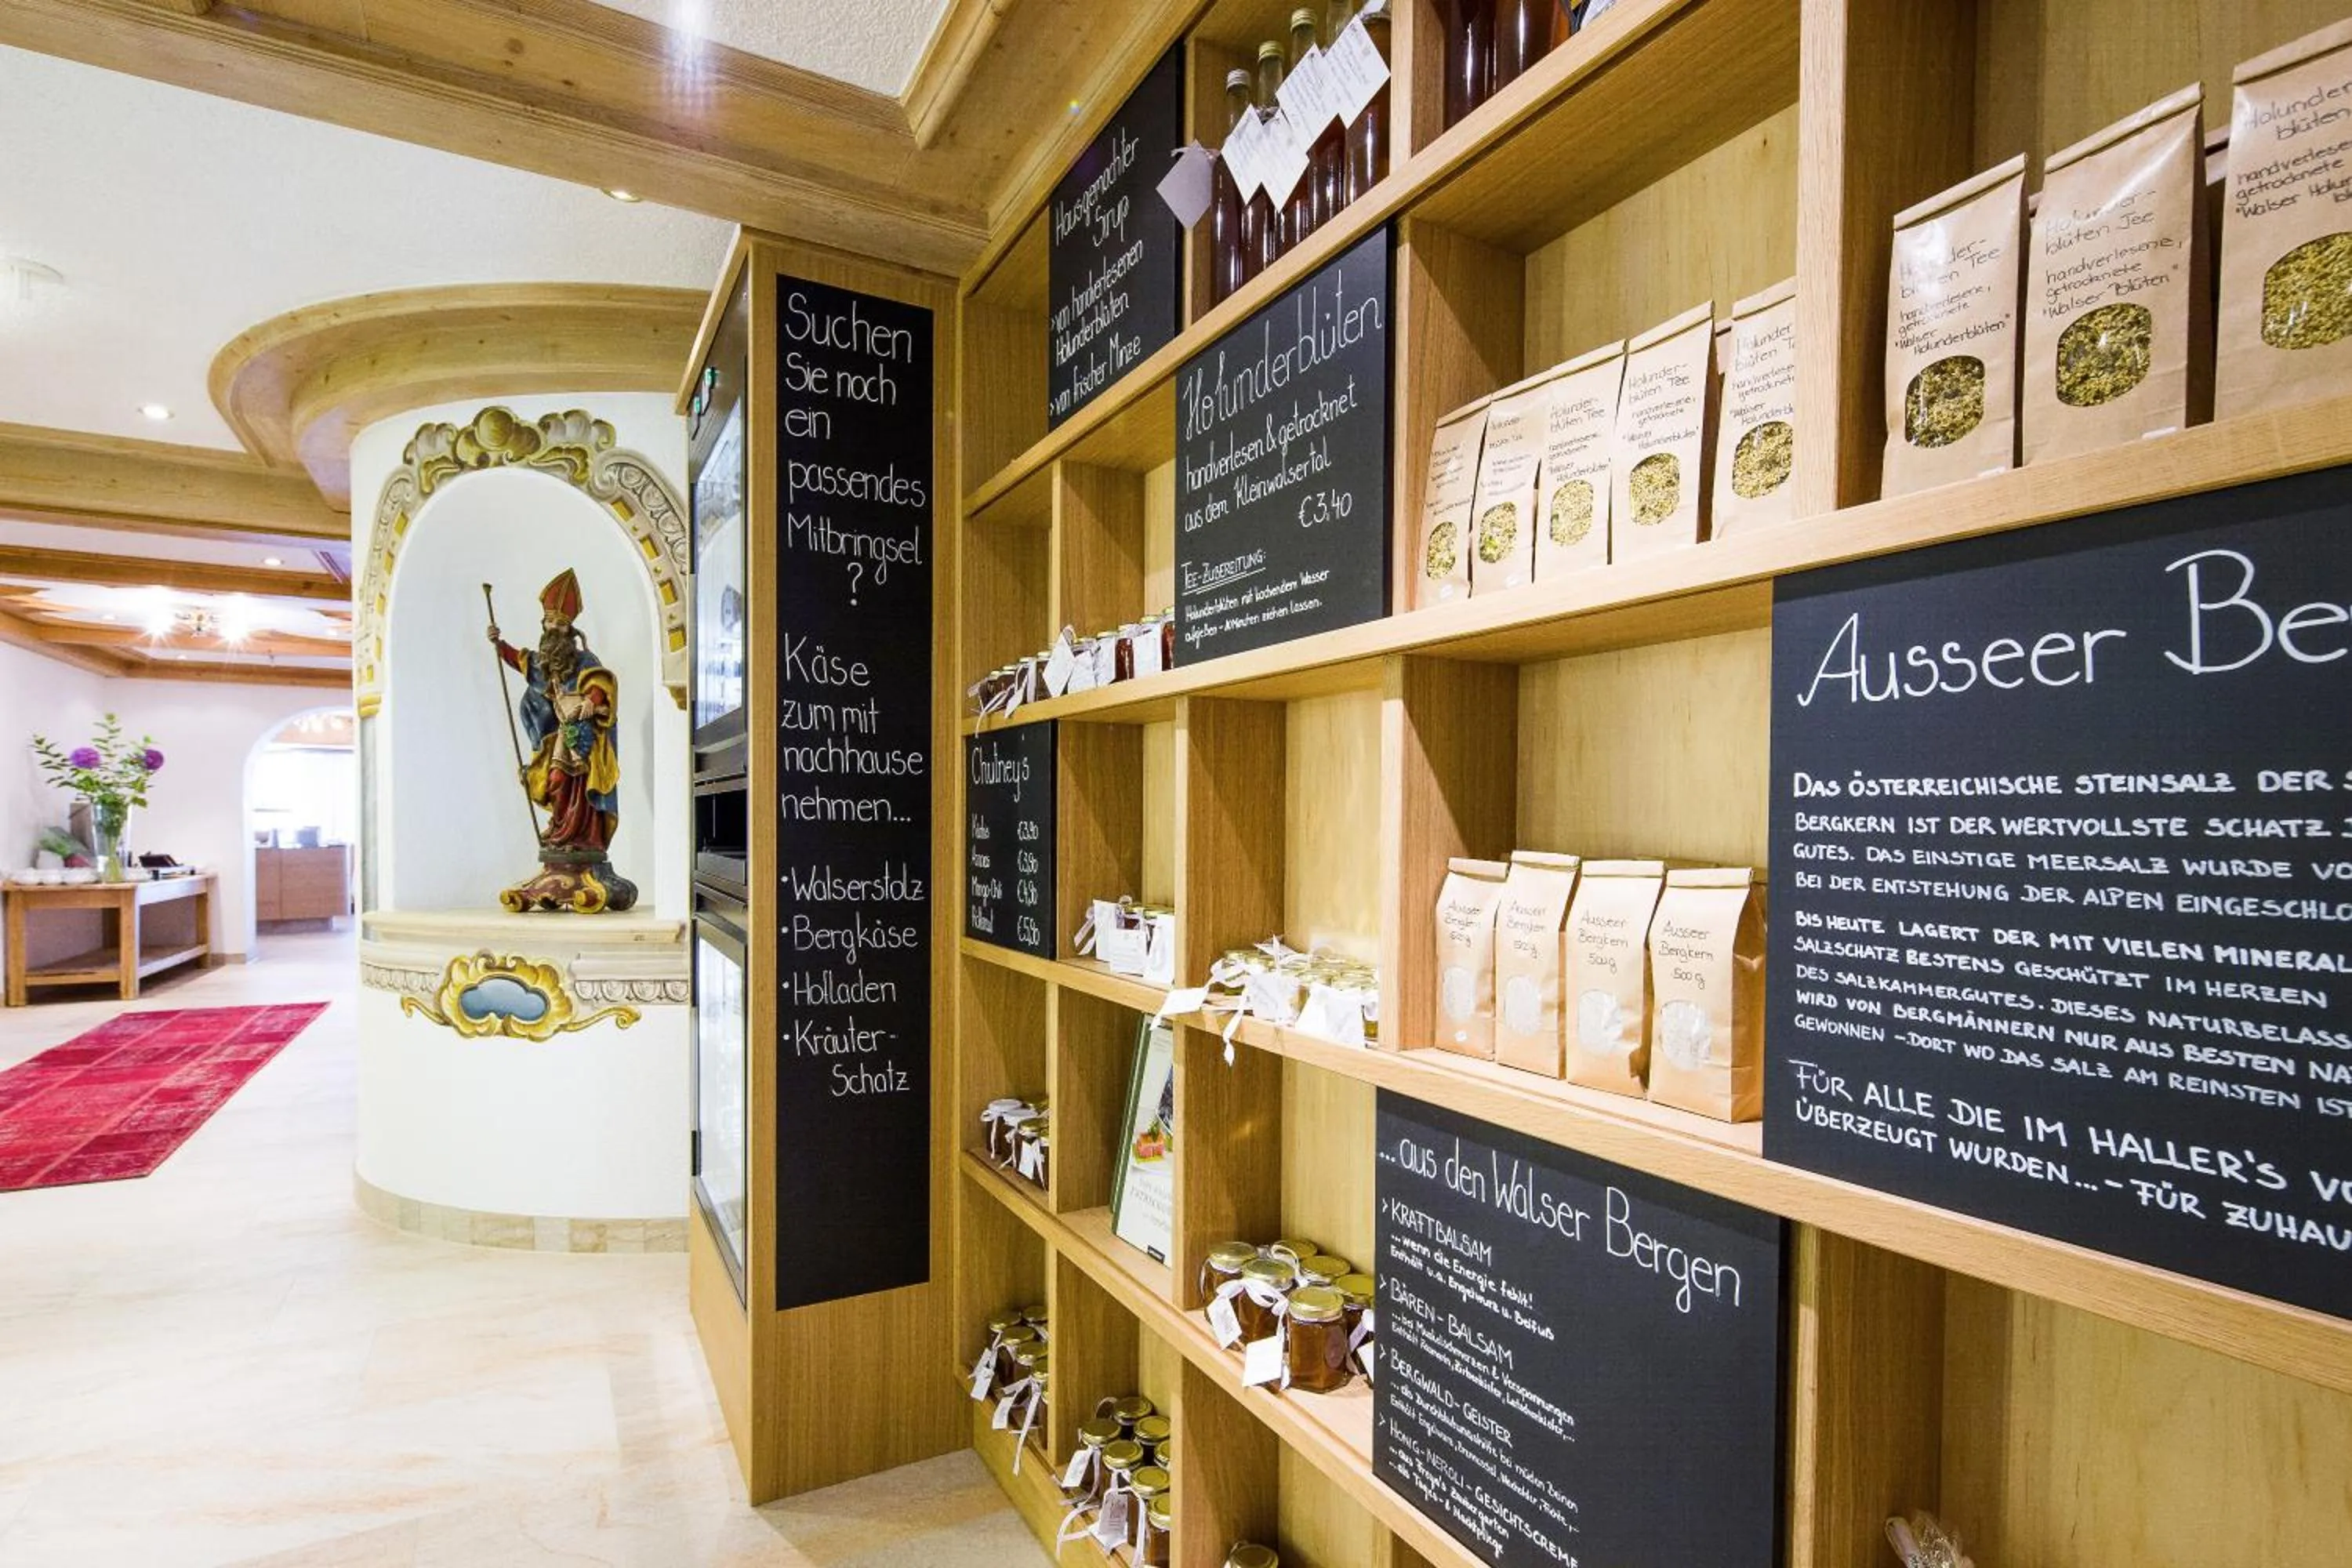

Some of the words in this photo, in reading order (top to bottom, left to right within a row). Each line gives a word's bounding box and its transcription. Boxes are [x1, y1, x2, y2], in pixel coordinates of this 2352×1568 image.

[785, 292, 912, 363] Suchen
[785, 352, 828, 393] Sie
[837, 363, 896, 405] noch
[1183, 269, 1382, 441] Holunderblüten
[785, 408, 830, 440] ein
[788, 459, 926, 507] passendes
[1186, 431, 1265, 495] handverlesen
[1185, 505, 1203, 532] aus
[1205, 492, 1230, 523] dem
[1298, 488, 1352, 528] €3,40
[788, 512, 923, 585] Mitbringsel
[847, 561, 863, 606] ?
[1798, 613, 2126, 706] Ausseer
[2165, 549, 2352, 674] Be
[785, 632, 871, 686] Käse
[782, 699, 835, 731] zum
[842, 697, 880, 735] mit
[783, 735, 924, 775] nachhause
[1849, 770, 2063, 797] ÖSTERREICHISCHE
[2074, 772, 2236, 795] STEINSALZ
[2258, 770, 2334, 793] DER
[1795, 811, 1895, 834] BERGKERN
[1907, 816, 1941, 834] IST
[1950, 816, 1997, 835] DER
[2002, 816, 2188, 837] WERTVOLLSTE
[2204, 818, 2332, 838] SCHATZ
[791, 859, 925, 901] Walserstolz
[1793, 843, 1855, 862] GUTES.
[1867, 846, 1905, 863] DAS
[1913, 848, 2016, 868] EINSTIGE
[2027, 854, 2170, 875] MEERSALZ
[2182, 858, 2292, 878] WURDE
[1795, 872, 1821, 888] BEI
[1829, 874, 1866, 892] DER
[1872, 877, 2009, 902] ENTSTEHUNG
[2020, 884, 2075, 903] DER
[2083, 887, 2165, 911] ALPEN
[793, 910, 919, 965] Bergkäse
[1795, 910, 1823, 927] BIS
[1826, 915, 1886, 934] HEUTE
[1898, 921, 1980, 942] LAGERT
[1992, 927, 2040, 948] DER
[2049, 932, 2094, 952] MIT
[2102, 937, 2205, 962] VIELEN
[793, 968, 897, 1007] Hofladen
[1793, 936, 1900, 964] SALZSCHATZ
[1905, 949, 2005, 975] BESTENS
[2014, 960, 2150, 989] GESCHÜTZT
[2165, 976, 2196, 995] IM
[2205, 981, 2328, 1009] HERZEN
[1795, 964, 1829, 982] DES
[2051, 998, 2136, 1023] DIESES
[1795, 989, 1838, 1009] WIRD
[1846, 997, 1882, 1015] VON
[1893, 1004, 2055, 1042] BERGMÄNNERN
[2064, 1028, 2119, 1051] NUR
[2125, 1036, 2175, 1058] AUS
[2183, 1044, 2296, 1076] BESTEN
[831, 1059, 910, 1097] Schatz
[1794, 1014, 1886, 1042] GEWONNEN
[1964, 1043, 1995, 1061] WO
[2000, 1048, 2045, 1069] DAS
[2050, 1057, 2113, 1078] SALZ
[2124, 1067, 2158, 1086] AM
[2168, 1072, 2302, 1109] REINSTEN
[1788, 1058, 1853, 1102] FÜR
[1864, 1081, 1935, 1119] ALLE
[1947, 1098, 2005, 1134] DIE
[2024, 1116, 2068, 1147] IM
[2089, 1126, 2288, 1191] HALLER'S
[1795, 1096, 1938, 1153] ÜBERZEUGT
[2129, 1178, 2207, 1220] FÜR
[1392, 1197, 1492, 1267] KRAFTBALSAM
[1445, 1136, 1485, 1203] den
[1492, 1149, 1591, 1241] Walser
[1606, 1185, 1740, 1313] Bergen
[1434, 1248, 1450, 1269] die
[1453, 1259, 1497, 1292] Energie
